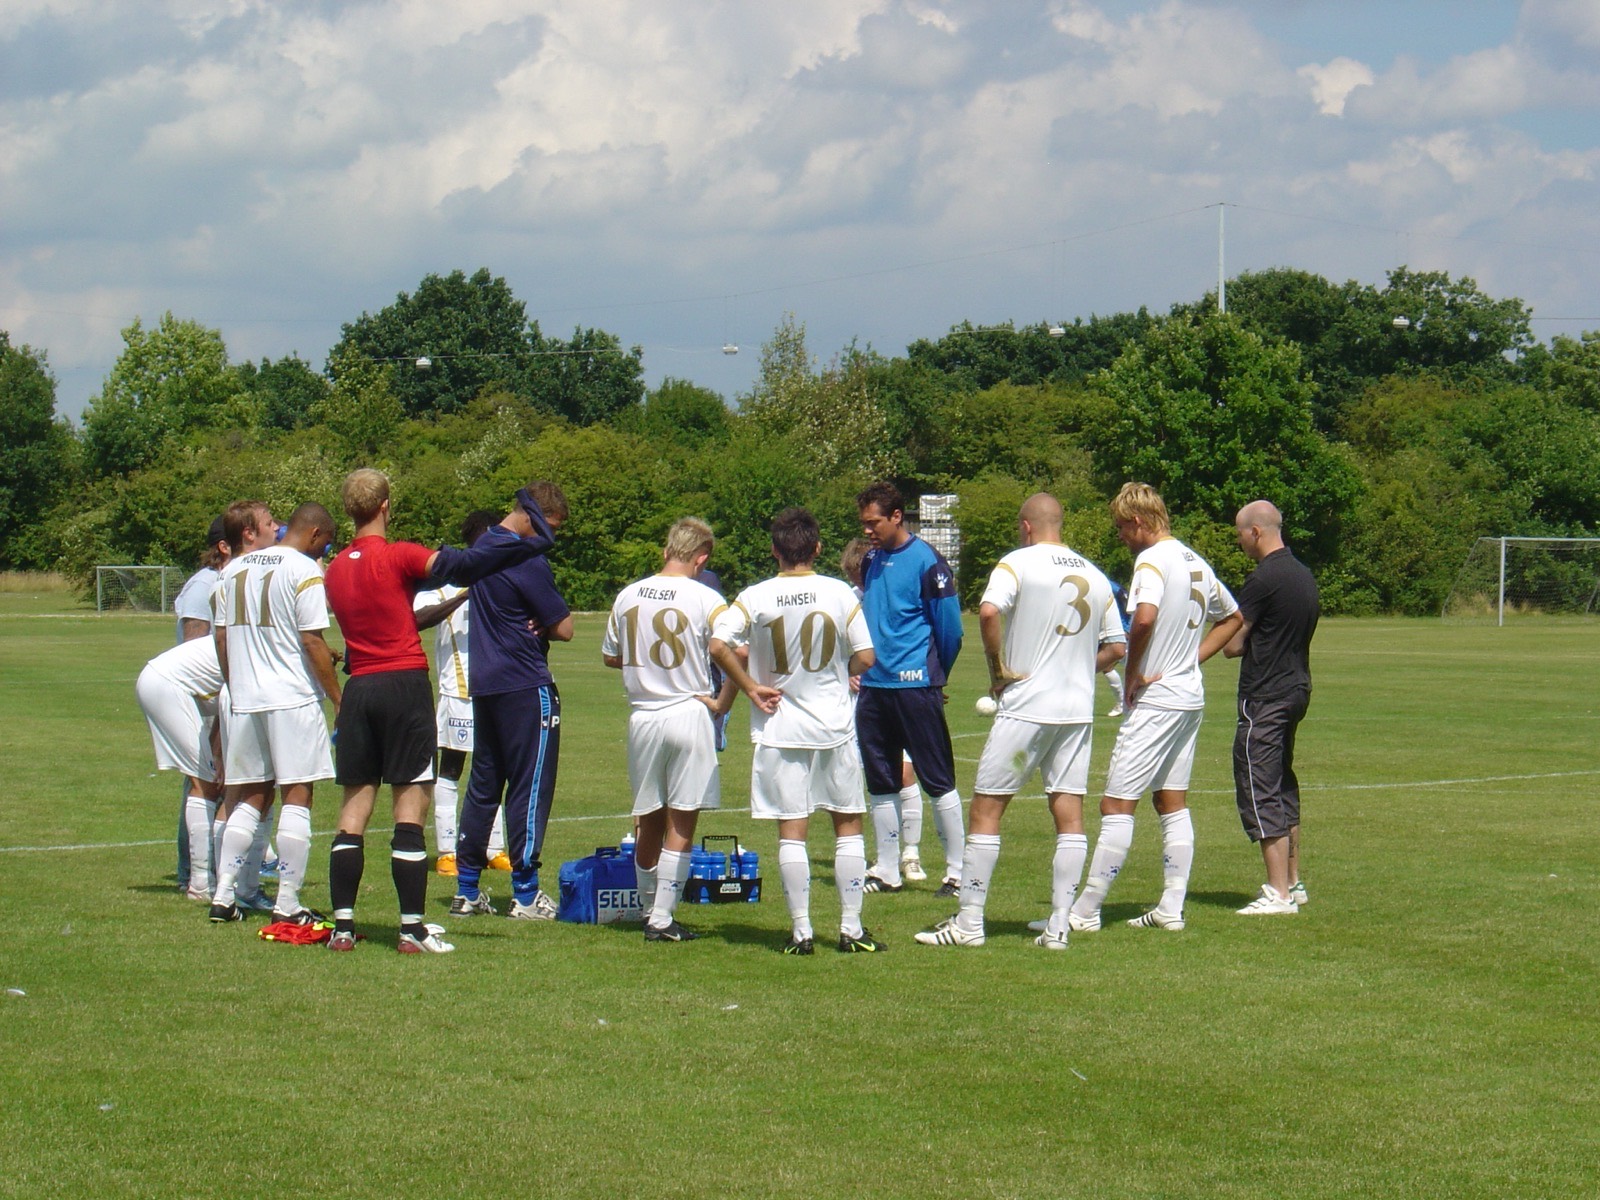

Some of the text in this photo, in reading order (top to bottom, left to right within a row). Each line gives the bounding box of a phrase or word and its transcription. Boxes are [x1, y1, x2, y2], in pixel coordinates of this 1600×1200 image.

[1051, 555, 1087, 568] LARSEN
[230, 568, 276, 627] 11
[637, 587, 677, 601] NIELSEN
[776, 592, 817, 607] HANSEN
[1055, 574, 1092, 637] 3
[1187, 571, 1206, 630] 5
[620, 605, 689, 670] 18
[762, 610, 837, 675] 10
[900, 669, 923, 682] MM
